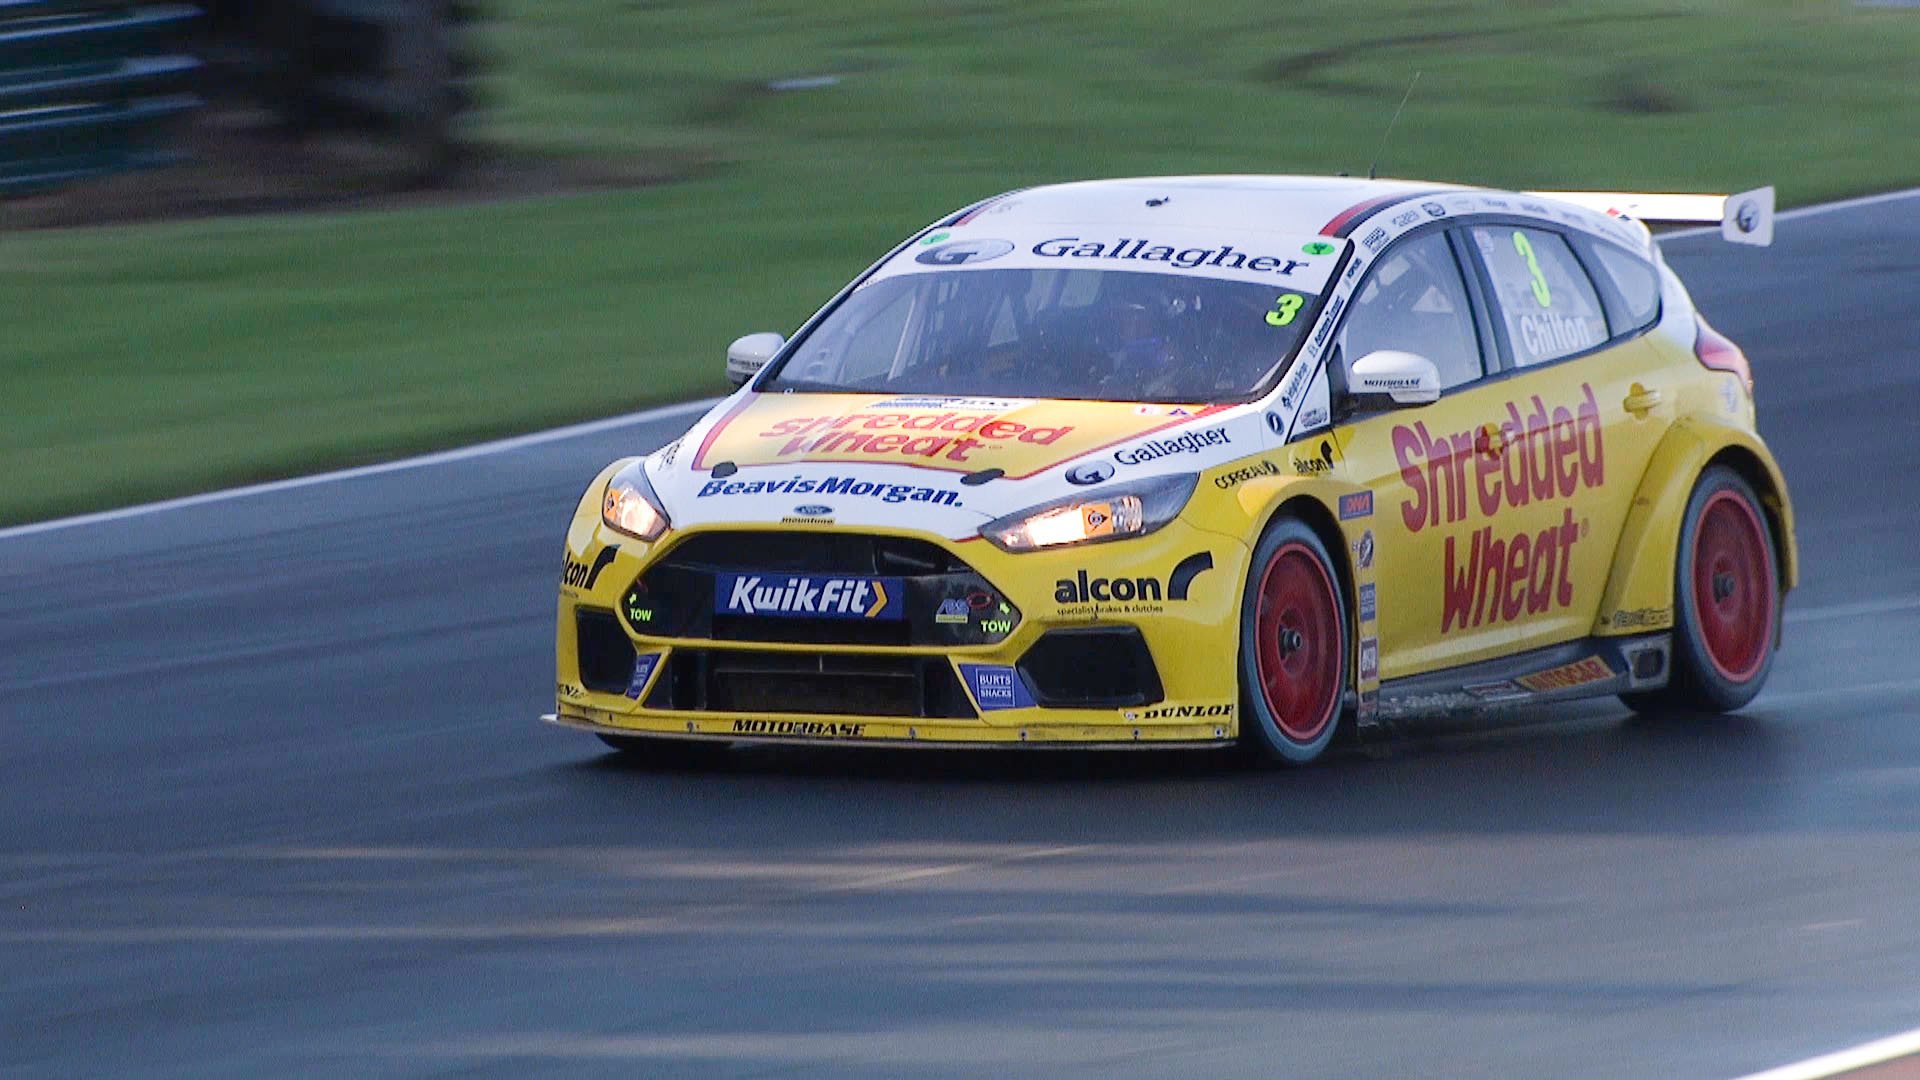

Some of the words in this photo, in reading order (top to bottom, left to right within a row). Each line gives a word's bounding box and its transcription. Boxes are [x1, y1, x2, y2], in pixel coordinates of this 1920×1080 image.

[1031, 237, 1309, 277] Gallagher
[1512, 230, 1552, 308] 3
[1264, 293, 1304, 327] 3
[1520, 311, 1591, 356] Chilton
[759, 411, 1074, 446] Shredded
[1113, 426, 1232, 466] Gallagher
[1392, 383, 1605, 533] Shredded
[562, 551, 588, 588] lcon
[1054, 569, 1162, 603] alcon
[1440, 507, 1579, 634] Wheat
[629, 607, 652, 622] TOW
[981, 620, 1011, 633] TOW
[979, 673, 1011, 685] BURTS
[981, 687, 1012, 698] SNACKS
[732, 718, 866, 737] MOTORBASE
[1143, 704, 1234, 719] DUNLOP
